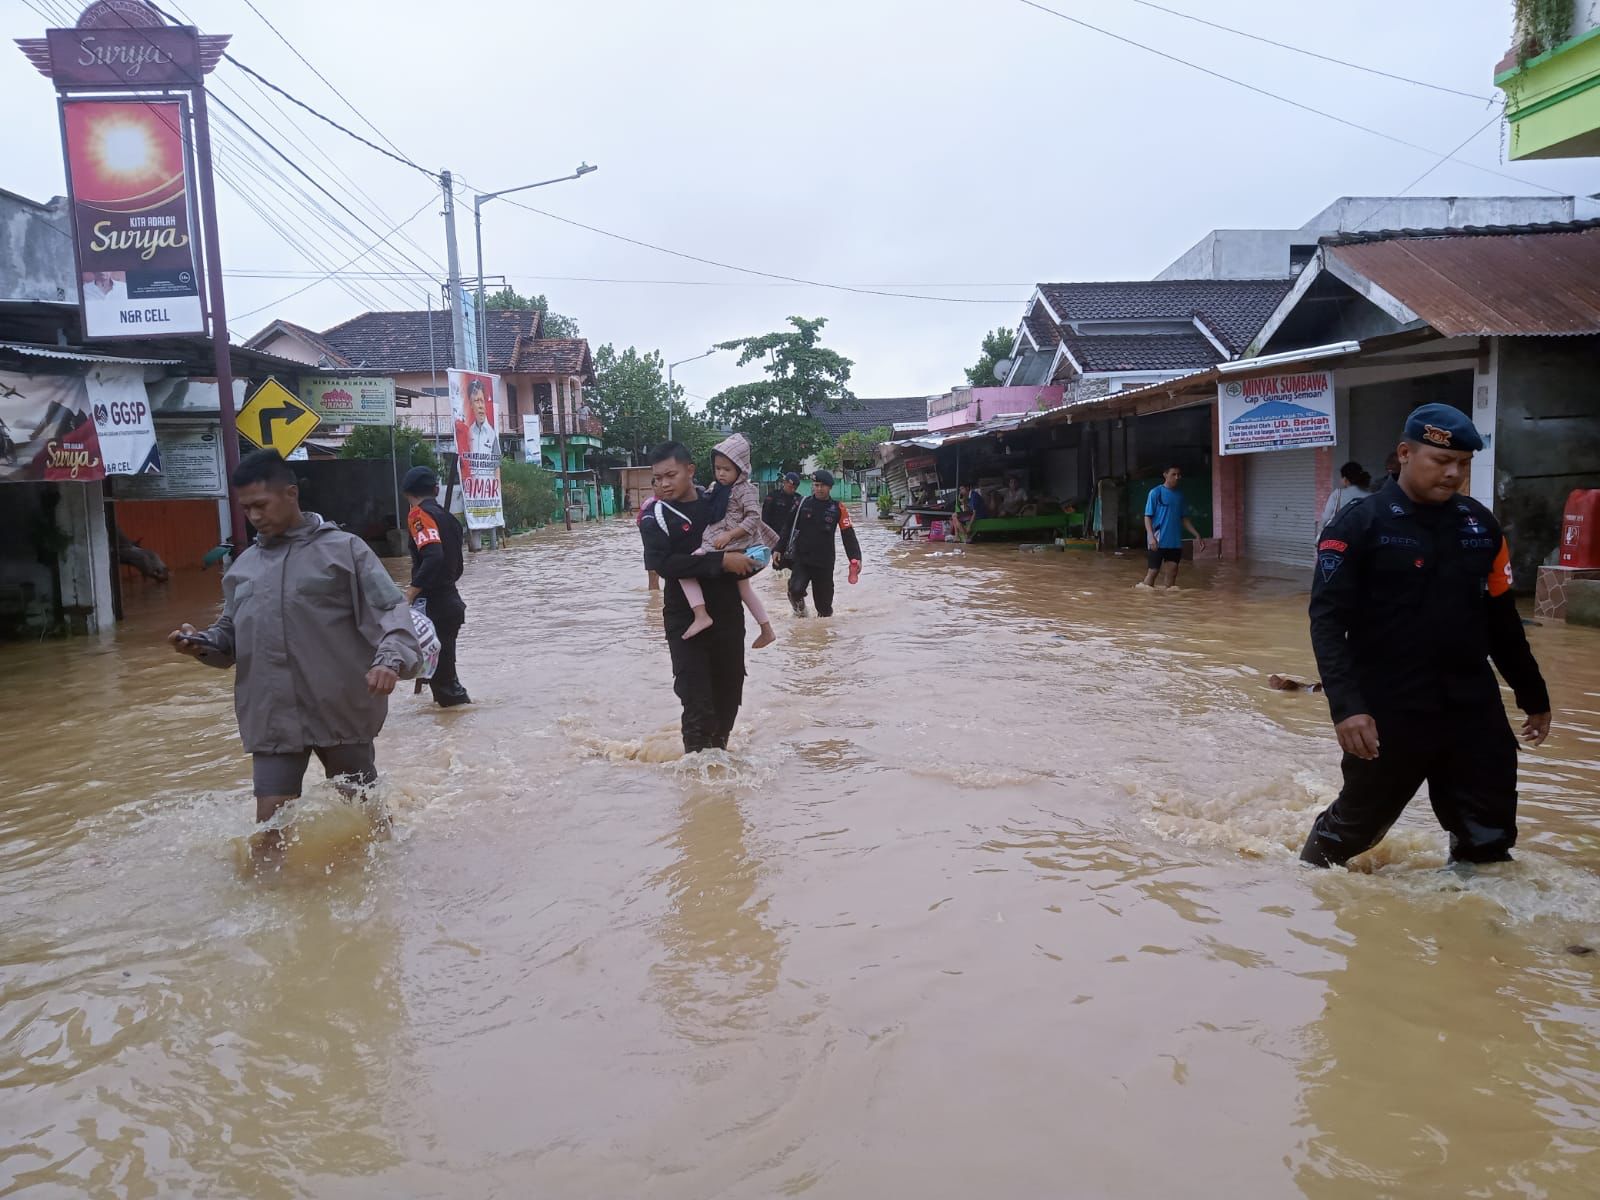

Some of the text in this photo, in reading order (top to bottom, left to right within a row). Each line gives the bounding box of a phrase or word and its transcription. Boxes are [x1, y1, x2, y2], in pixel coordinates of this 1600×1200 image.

[78, 36, 173, 77] Surya
[129, 215, 176, 228] KITA ADALAH
[90, 220, 189, 261] Surya
[119, 308, 171, 324] N&R CELL
[1242, 373, 1329, 397] MINYAK SUMBAWA
[1244, 395, 1259, 405] Cap
[110, 401, 146, 426] GGSP
[1273, 420, 1291, 428] UD.
[1293, 417, 1329, 427] Berkah
[46, 441, 99, 478] Surya
[464, 478, 499, 498] AMAR
[413, 528, 441, 545] AR
